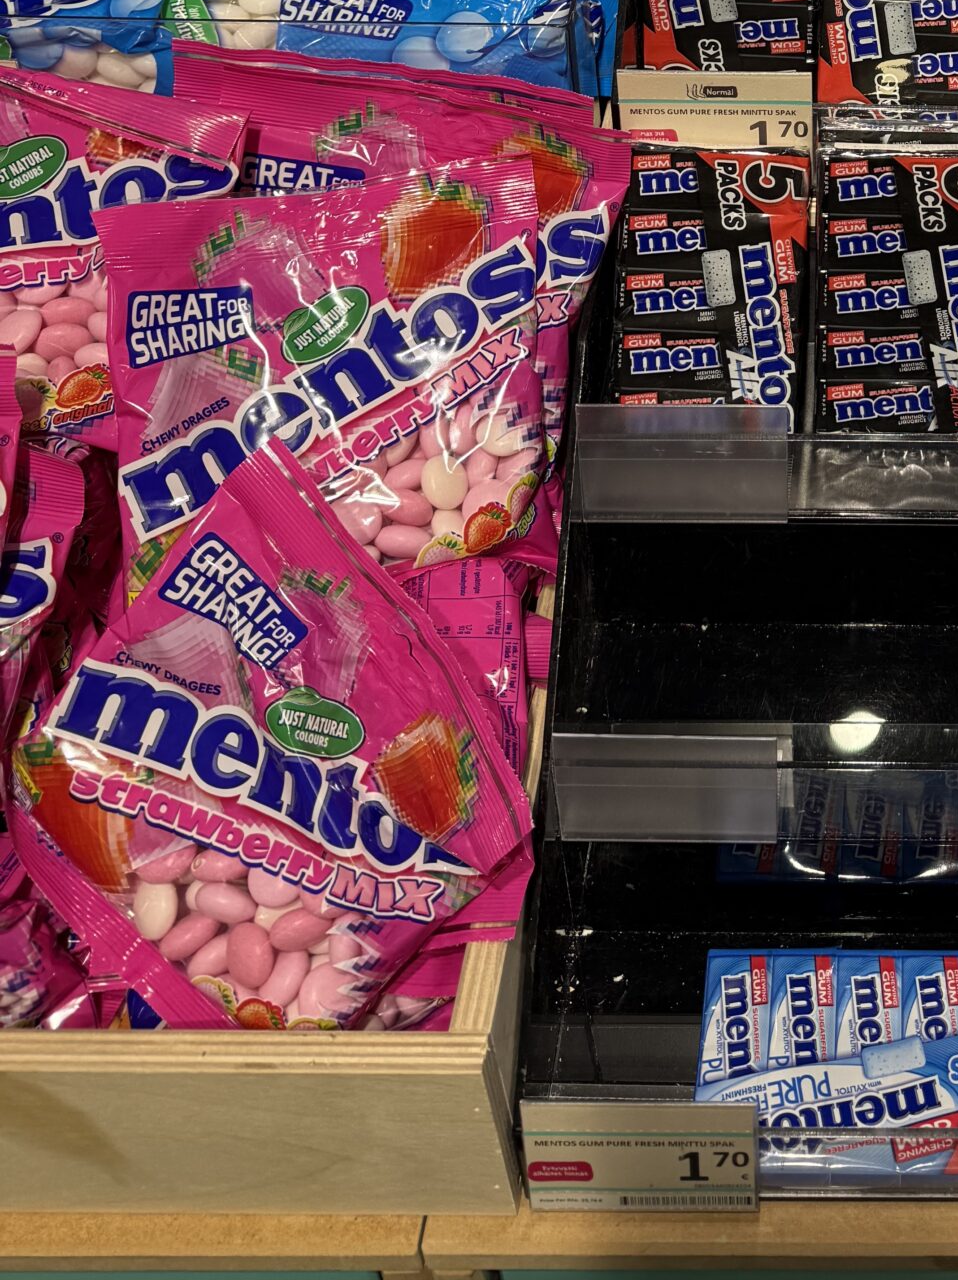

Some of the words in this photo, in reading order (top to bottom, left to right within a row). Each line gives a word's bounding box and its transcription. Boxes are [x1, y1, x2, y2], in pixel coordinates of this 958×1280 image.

[629, 108, 666, 116] MENTOS
[667, 108, 688, 116] GUM
[690, 108, 711, 116] PURE
[713, 109, 739, 117] FRESH
[741, 109, 773, 117] MINTTU
[706, 87, 734, 97] Normal
[131, 292, 218, 331] GREAT
[217, 297, 248, 316] FOR
[119, 234, 537, 542] mentos
[189, 538, 281, 632] GREAT
[264, 616, 296, 649] FOR
[165, 566, 284, 668] SHARING!
[115, 650, 162, 675] CHEWY
[163, 668, 222, 697] DRAGEES
[278, 708, 304, 727] JUST
[305, 715, 350, 740] NATURAL
[294, 731, 329, 749] COLOURS
[69, 768, 336, 898] strawberry
[327, 862, 444, 920] MIX
